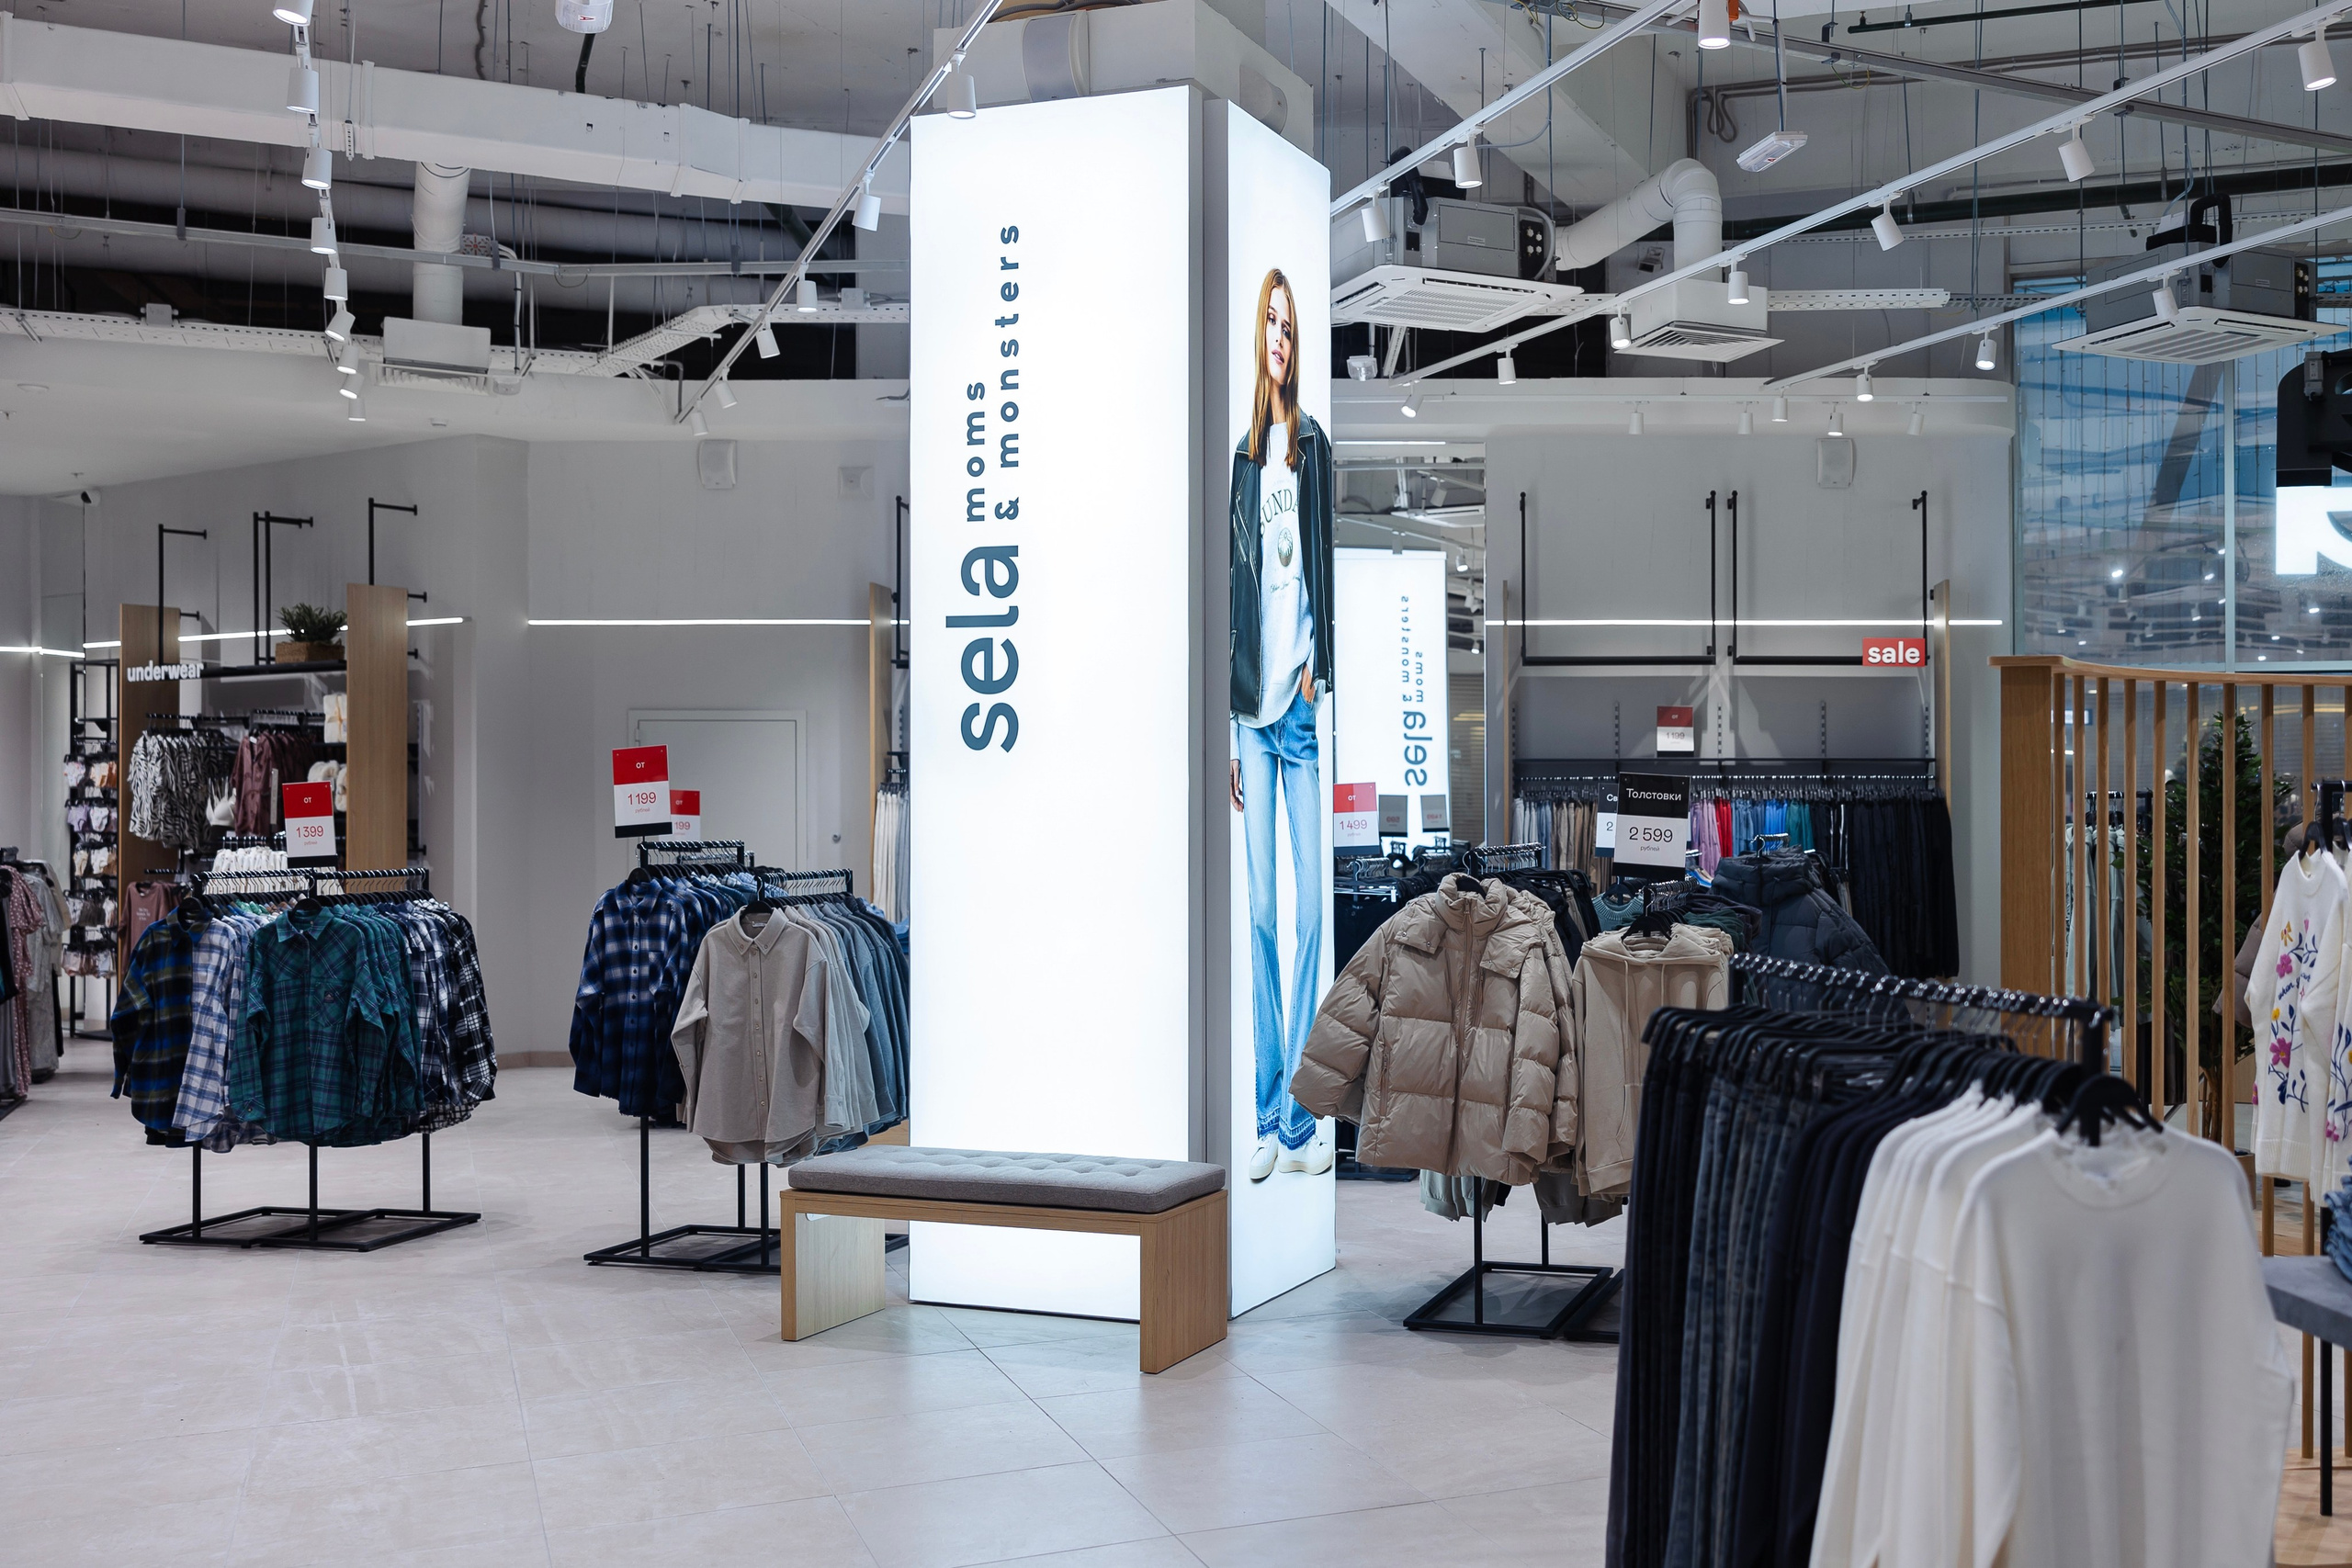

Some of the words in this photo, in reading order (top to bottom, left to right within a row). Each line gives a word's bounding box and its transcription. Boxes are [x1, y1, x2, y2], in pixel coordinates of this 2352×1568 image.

[994, 225, 1020, 468] monsters
[967, 381, 986, 522] moms
[994, 496, 1020, 521] &
[945, 545, 1020, 753] sela
[1868, 640, 1921, 664] sale
[127, 660, 204, 682] underwear
[1625, 788, 1682, 802] Толстовки
